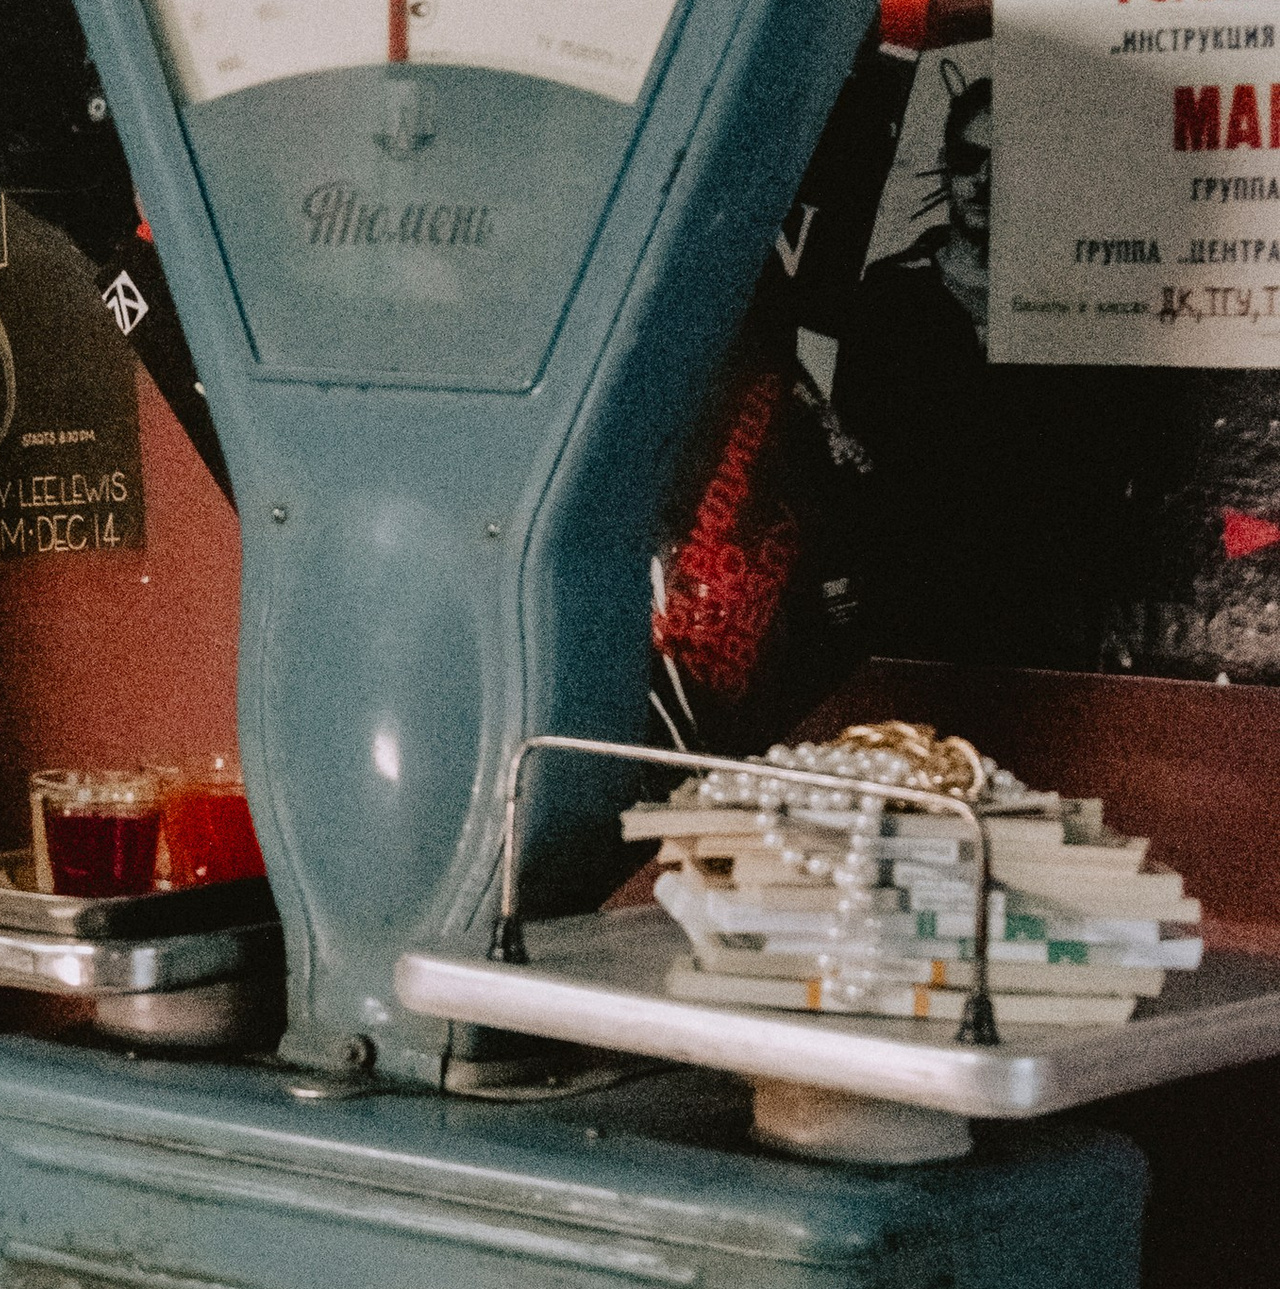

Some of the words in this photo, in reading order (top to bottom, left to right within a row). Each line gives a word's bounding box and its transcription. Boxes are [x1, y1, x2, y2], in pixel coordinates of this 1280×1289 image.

[1075, 238, 1162, 266] ГРУППА
[36, 513, 88, 553] DEC
[93, 511, 121, 550] 14
